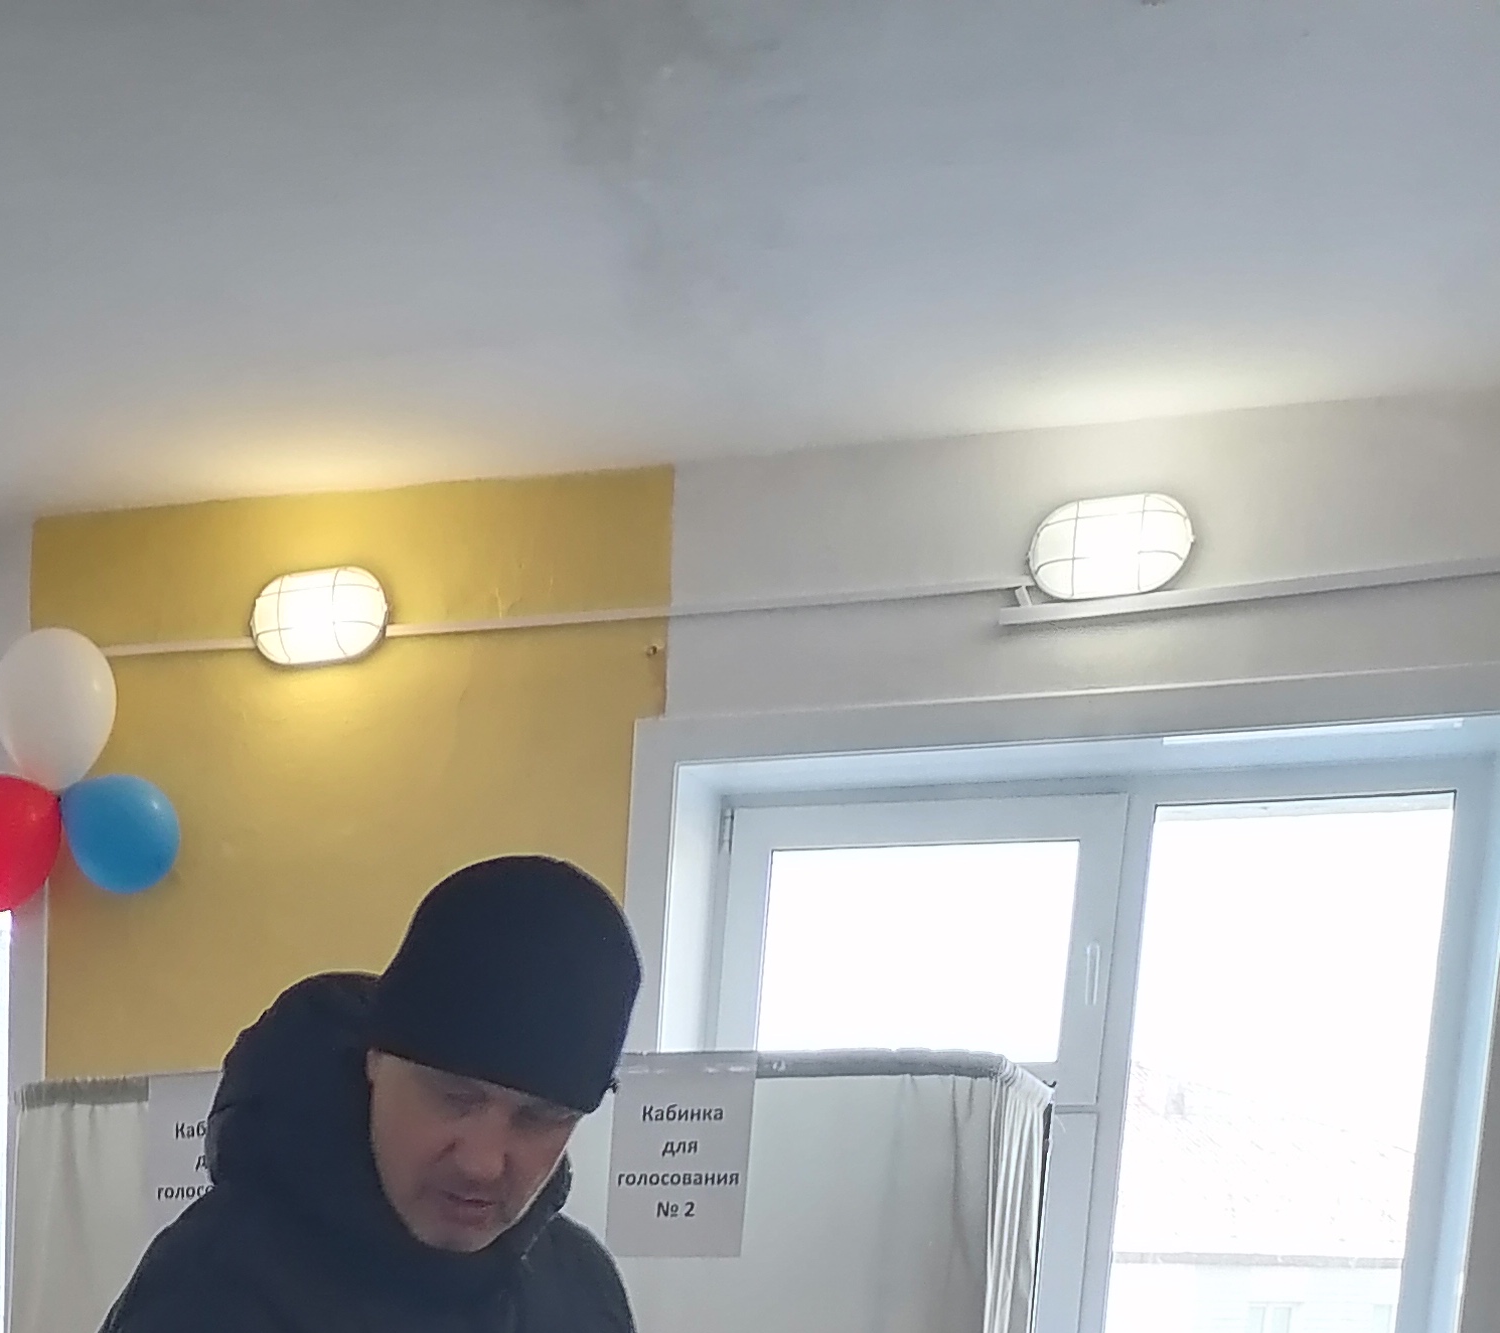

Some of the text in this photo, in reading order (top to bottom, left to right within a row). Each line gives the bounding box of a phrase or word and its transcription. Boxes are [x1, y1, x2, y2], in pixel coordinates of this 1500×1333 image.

[642, 1104, 724, 1121] Кабинка
[175, 1120, 207, 1140] Каб
[662, 1140, 698, 1157] для
[618, 1172, 740, 1187] голосования
[656, 1201, 695, 1218] № 2
